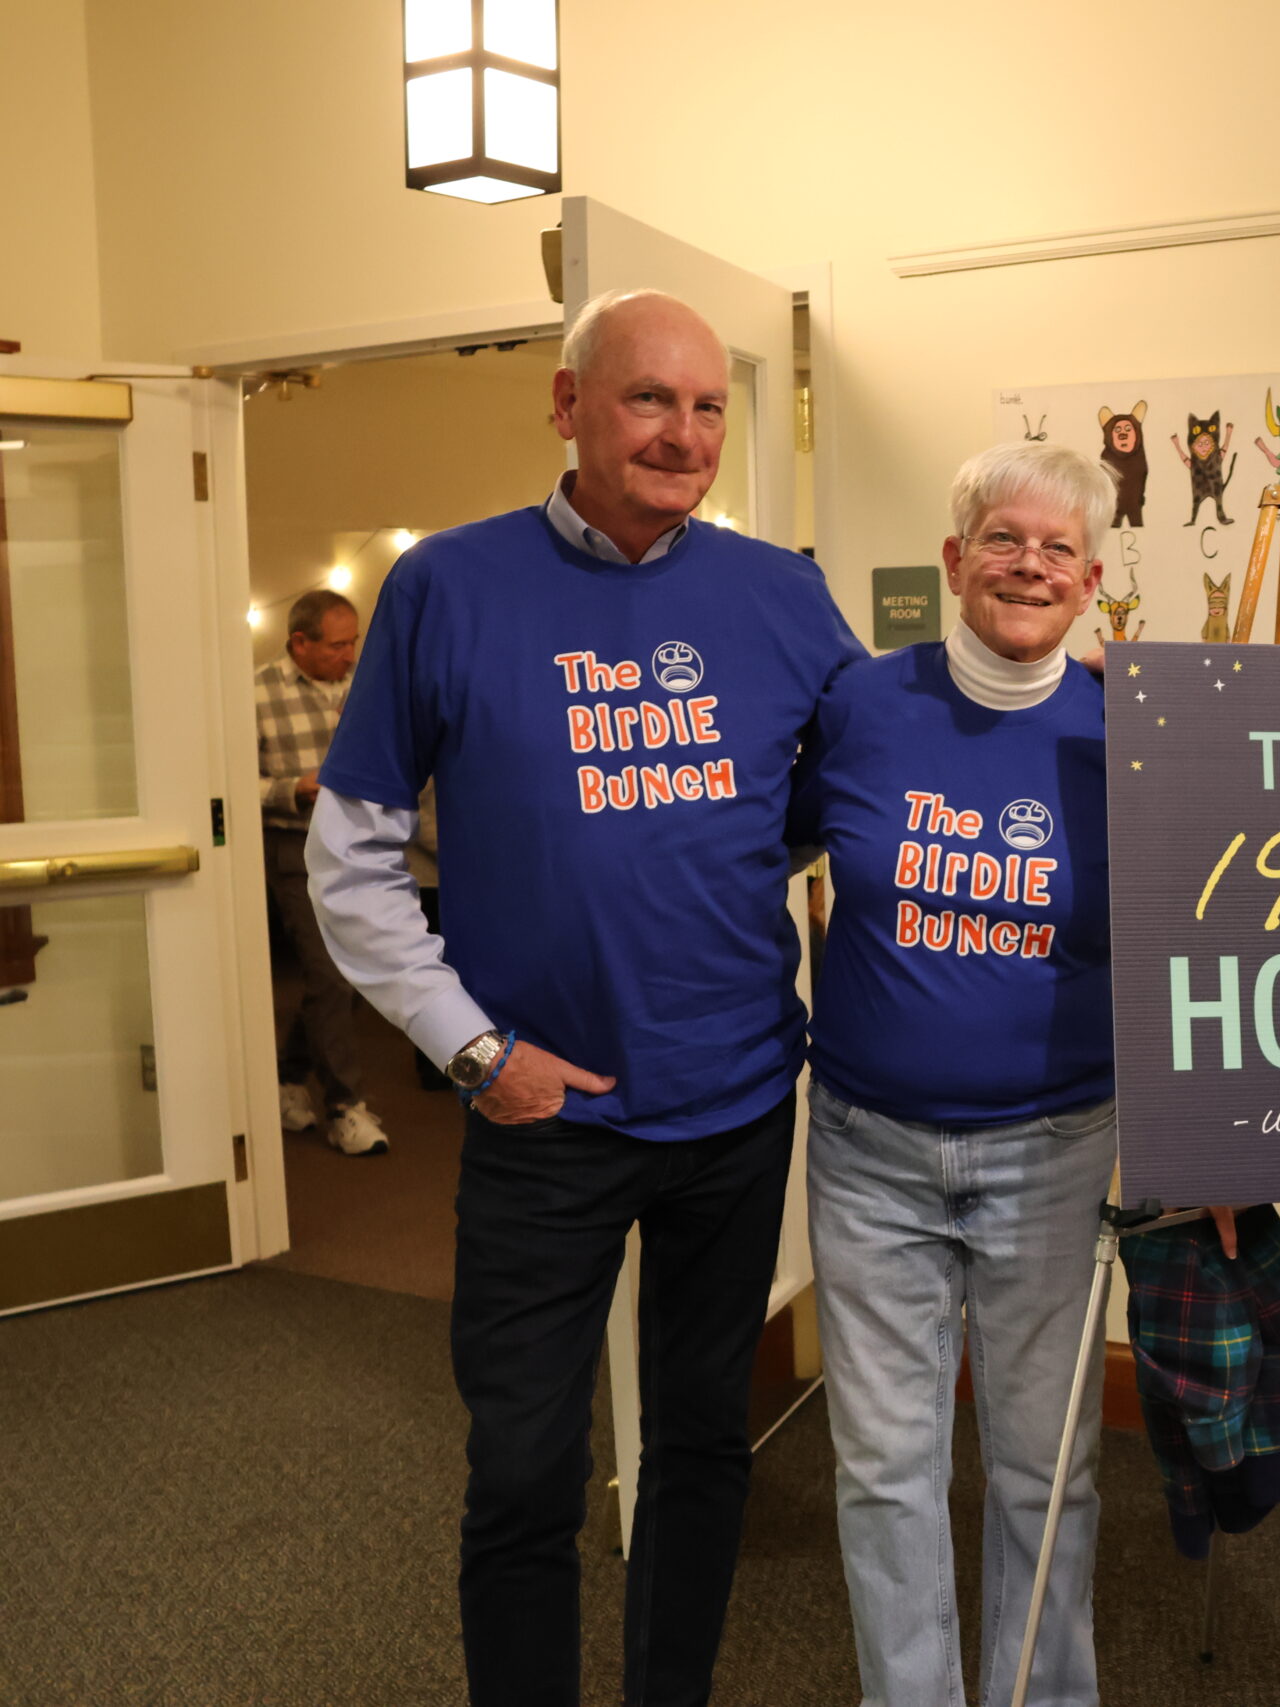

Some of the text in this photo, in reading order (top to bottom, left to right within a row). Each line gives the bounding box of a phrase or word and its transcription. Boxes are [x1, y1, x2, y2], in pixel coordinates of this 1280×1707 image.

[1119, 530, 1142, 567] B
[1200, 526, 1220, 559] C
[882, 595, 929, 607] MEETING
[889, 608, 922, 619] ROOM
[554, 651, 642, 694] The
[905, 790, 984, 840] The
